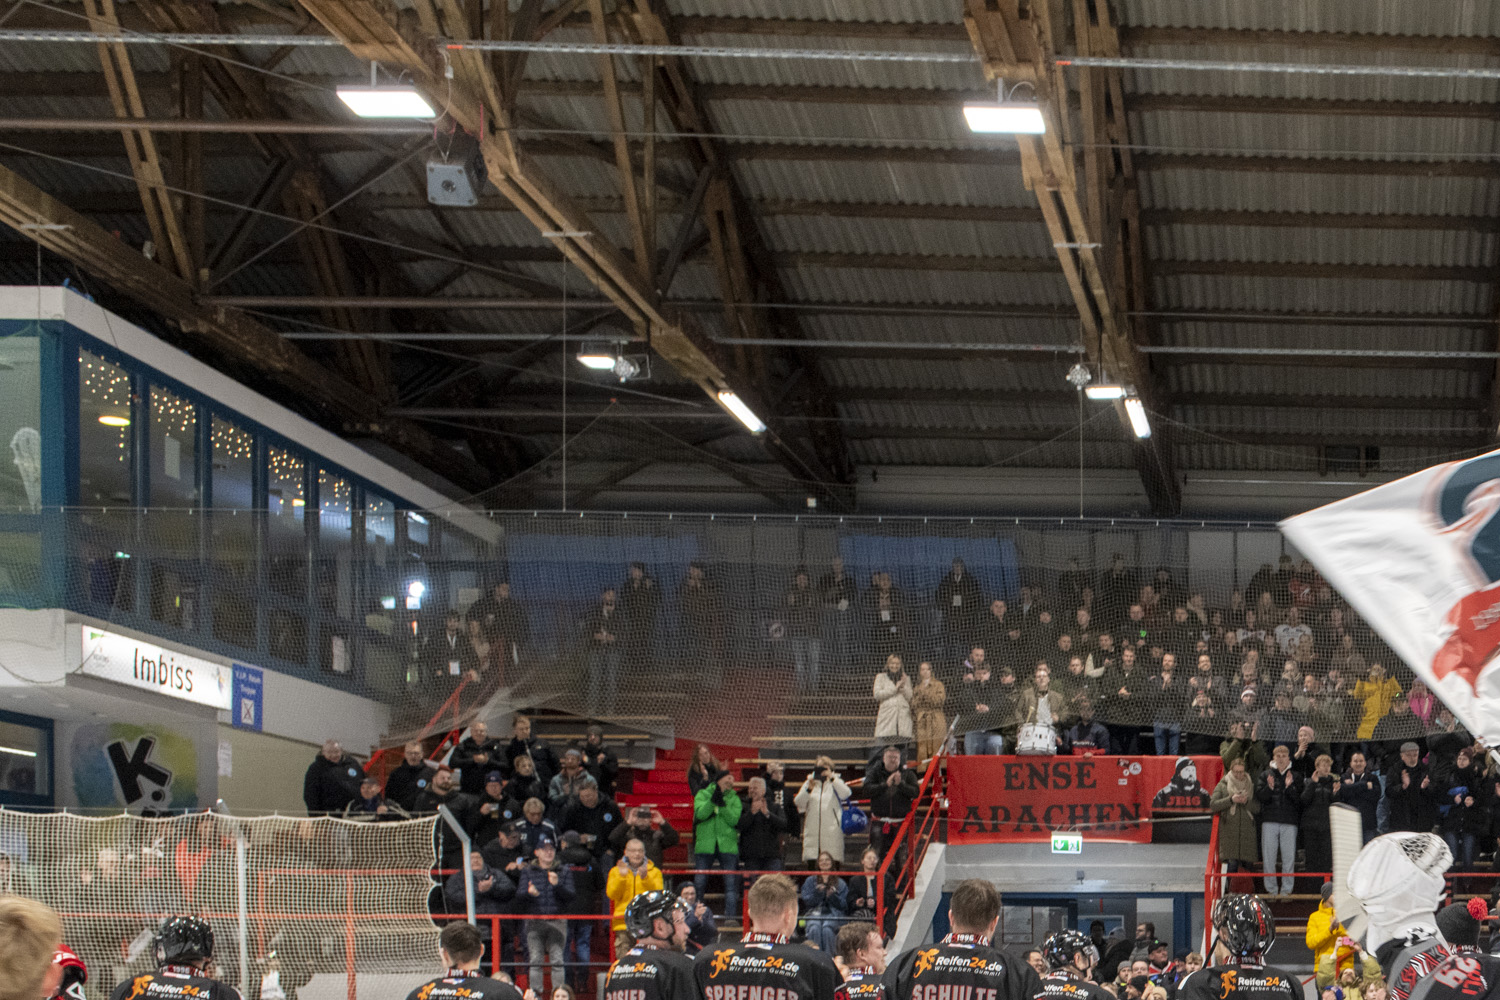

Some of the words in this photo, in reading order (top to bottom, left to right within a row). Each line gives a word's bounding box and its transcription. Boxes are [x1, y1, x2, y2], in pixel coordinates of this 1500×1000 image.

[133, 647, 194, 693] Imbiss
[1003, 761, 1097, 791] ENSE
[958, 803, 1142, 834] APACHEN
[730, 956, 799, 973] Reifen24.de
[935, 956, 1002, 972] Reifen24.de
